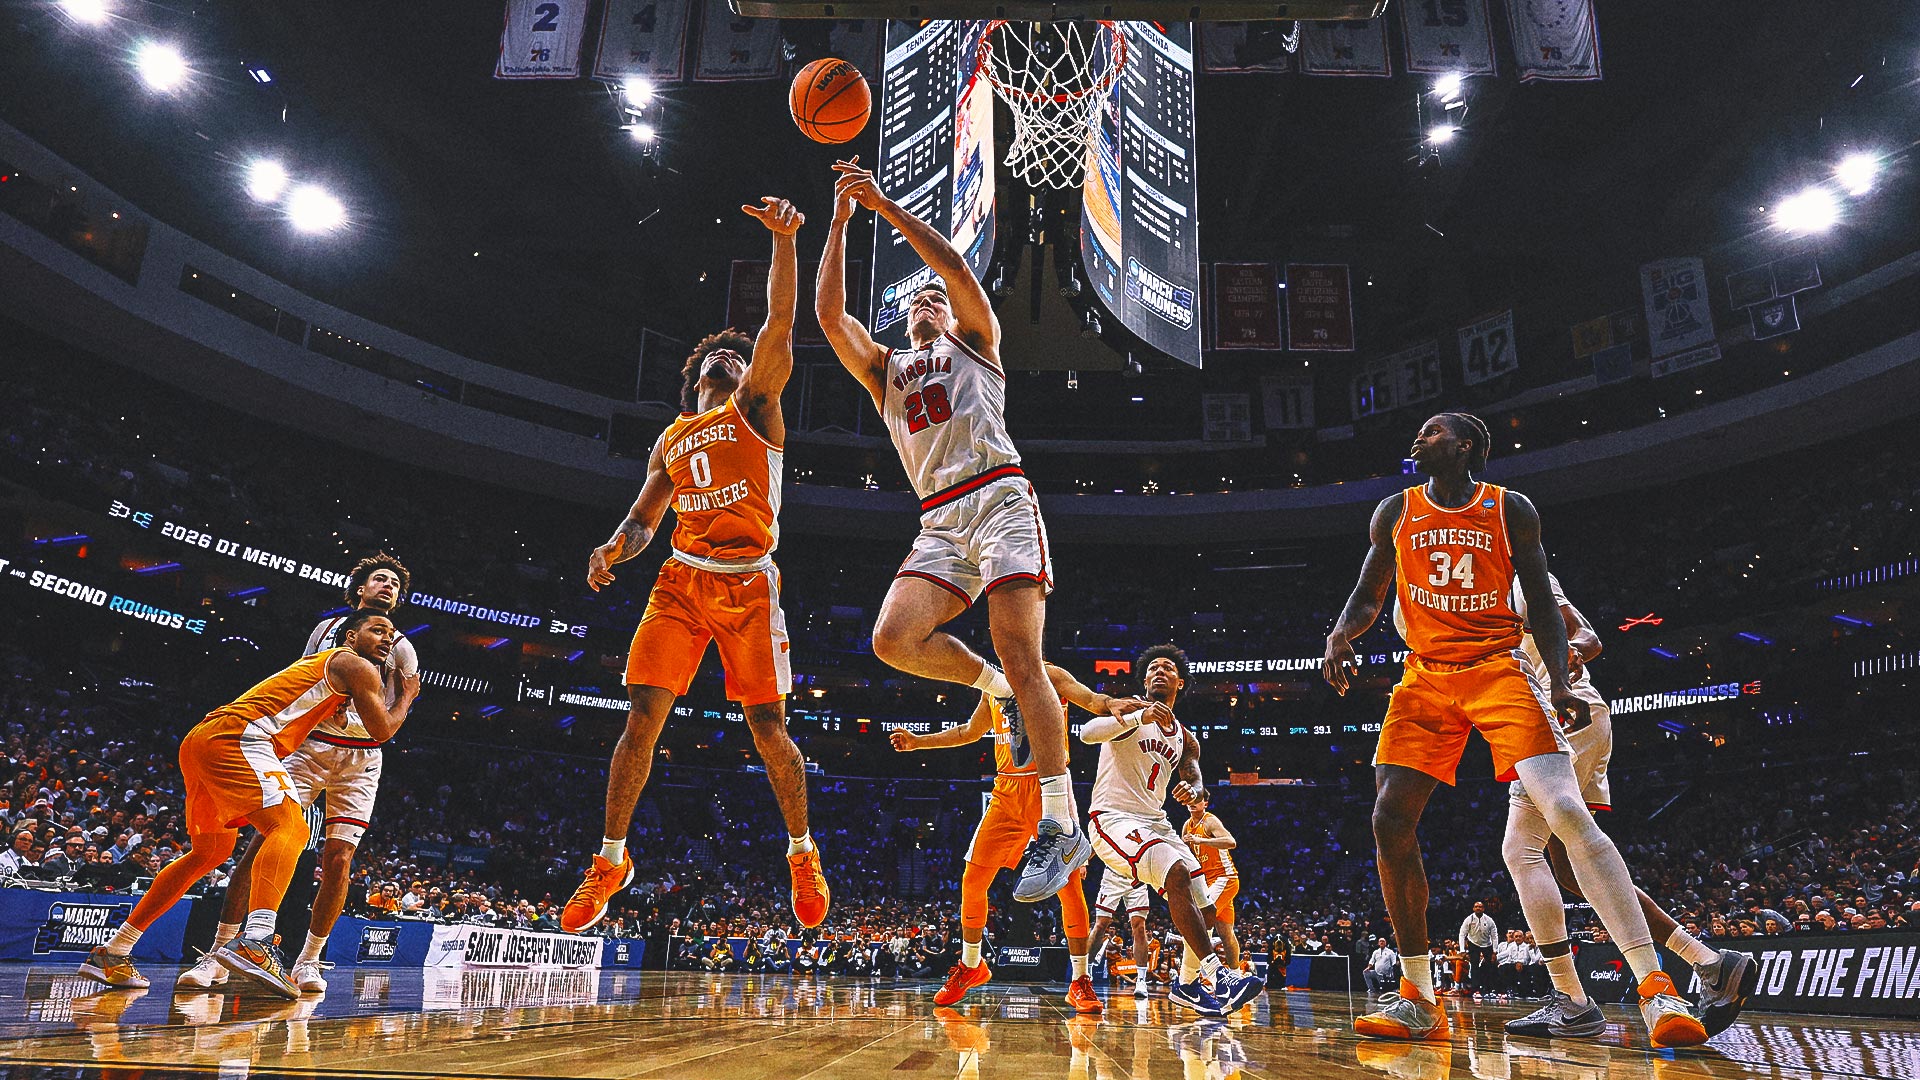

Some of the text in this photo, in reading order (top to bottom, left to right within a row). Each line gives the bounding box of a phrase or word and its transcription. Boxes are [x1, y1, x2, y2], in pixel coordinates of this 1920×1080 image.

[532, 3, 560, 32] 2
[632, 3, 657, 33] 4
[1423, 0, 1469, 27] 15
[530, 49, 550, 62] 76
[1439, 44, 1460, 57] 76
[1540, 46, 1562, 60] 76
[895, 267, 930, 300] MARCH
[1138, 266, 1173, 300] MARCH
[1142, 288, 1192, 325] MADNESS
[1313, 328, 1329, 340] 76
[1468, 330, 1509, 378] 42
[904, 383, 952, 435] 28
[666, 424, 737, 468] TENNESSEE
[690, 451, 712, 488] 0
[161, 522, 212, 549] 2026
[216, 539, 240, 557] DI
[242, 547, 297, 573] MEN'S
[1410, 528, 1493, 552] TENNESSEE
[1428, 551, 1475, 589] 34
[10, 569, 26, 578] AND
[30, 571, 107, 606] SECOND
[109, 595, 185, 629] ROUNDS
[410, 593, 541, 628] CHAMPIONSHIP
[1408, 583, 1498, 612] VOLUNTEERS
[1188, 659, 1262, 673] ENNESSEE
[1370, 654, 1386, 664] VS
[1392, 651, 1413, 663] VI
[526, 688, 544, 699] 7:45
[674, 707, 693, 717] 46.7
[1610, 682, 1740, 716] MARCHMADNESS
[726, 713, 744, 722] 42.9
[881, 722, 931, 732] TENNESSEE
[1260, 727, 1278, 736] 39.1
[1313, 725, 1332, 735] 39.1
[1361, 723, 1381, 733] 42.9
[263, 771, 291, 791] T
[1147, 762, 1160, 792] 1
[1125, 829, 1143, 845] V
[64, 908, 109, 927] MARCH
[62, 926, 118, 944] MADNES
[369, 930, 391, 942] MARCH
[465, 932, 503, 962] SAINT
[503, 935, 550, 964] JOSEPH'S
[551, 938, 597, 965] UNIVERSITY
[1755, 950, 1792, 996] TO
[1795, 949, 1855, 997] THE
